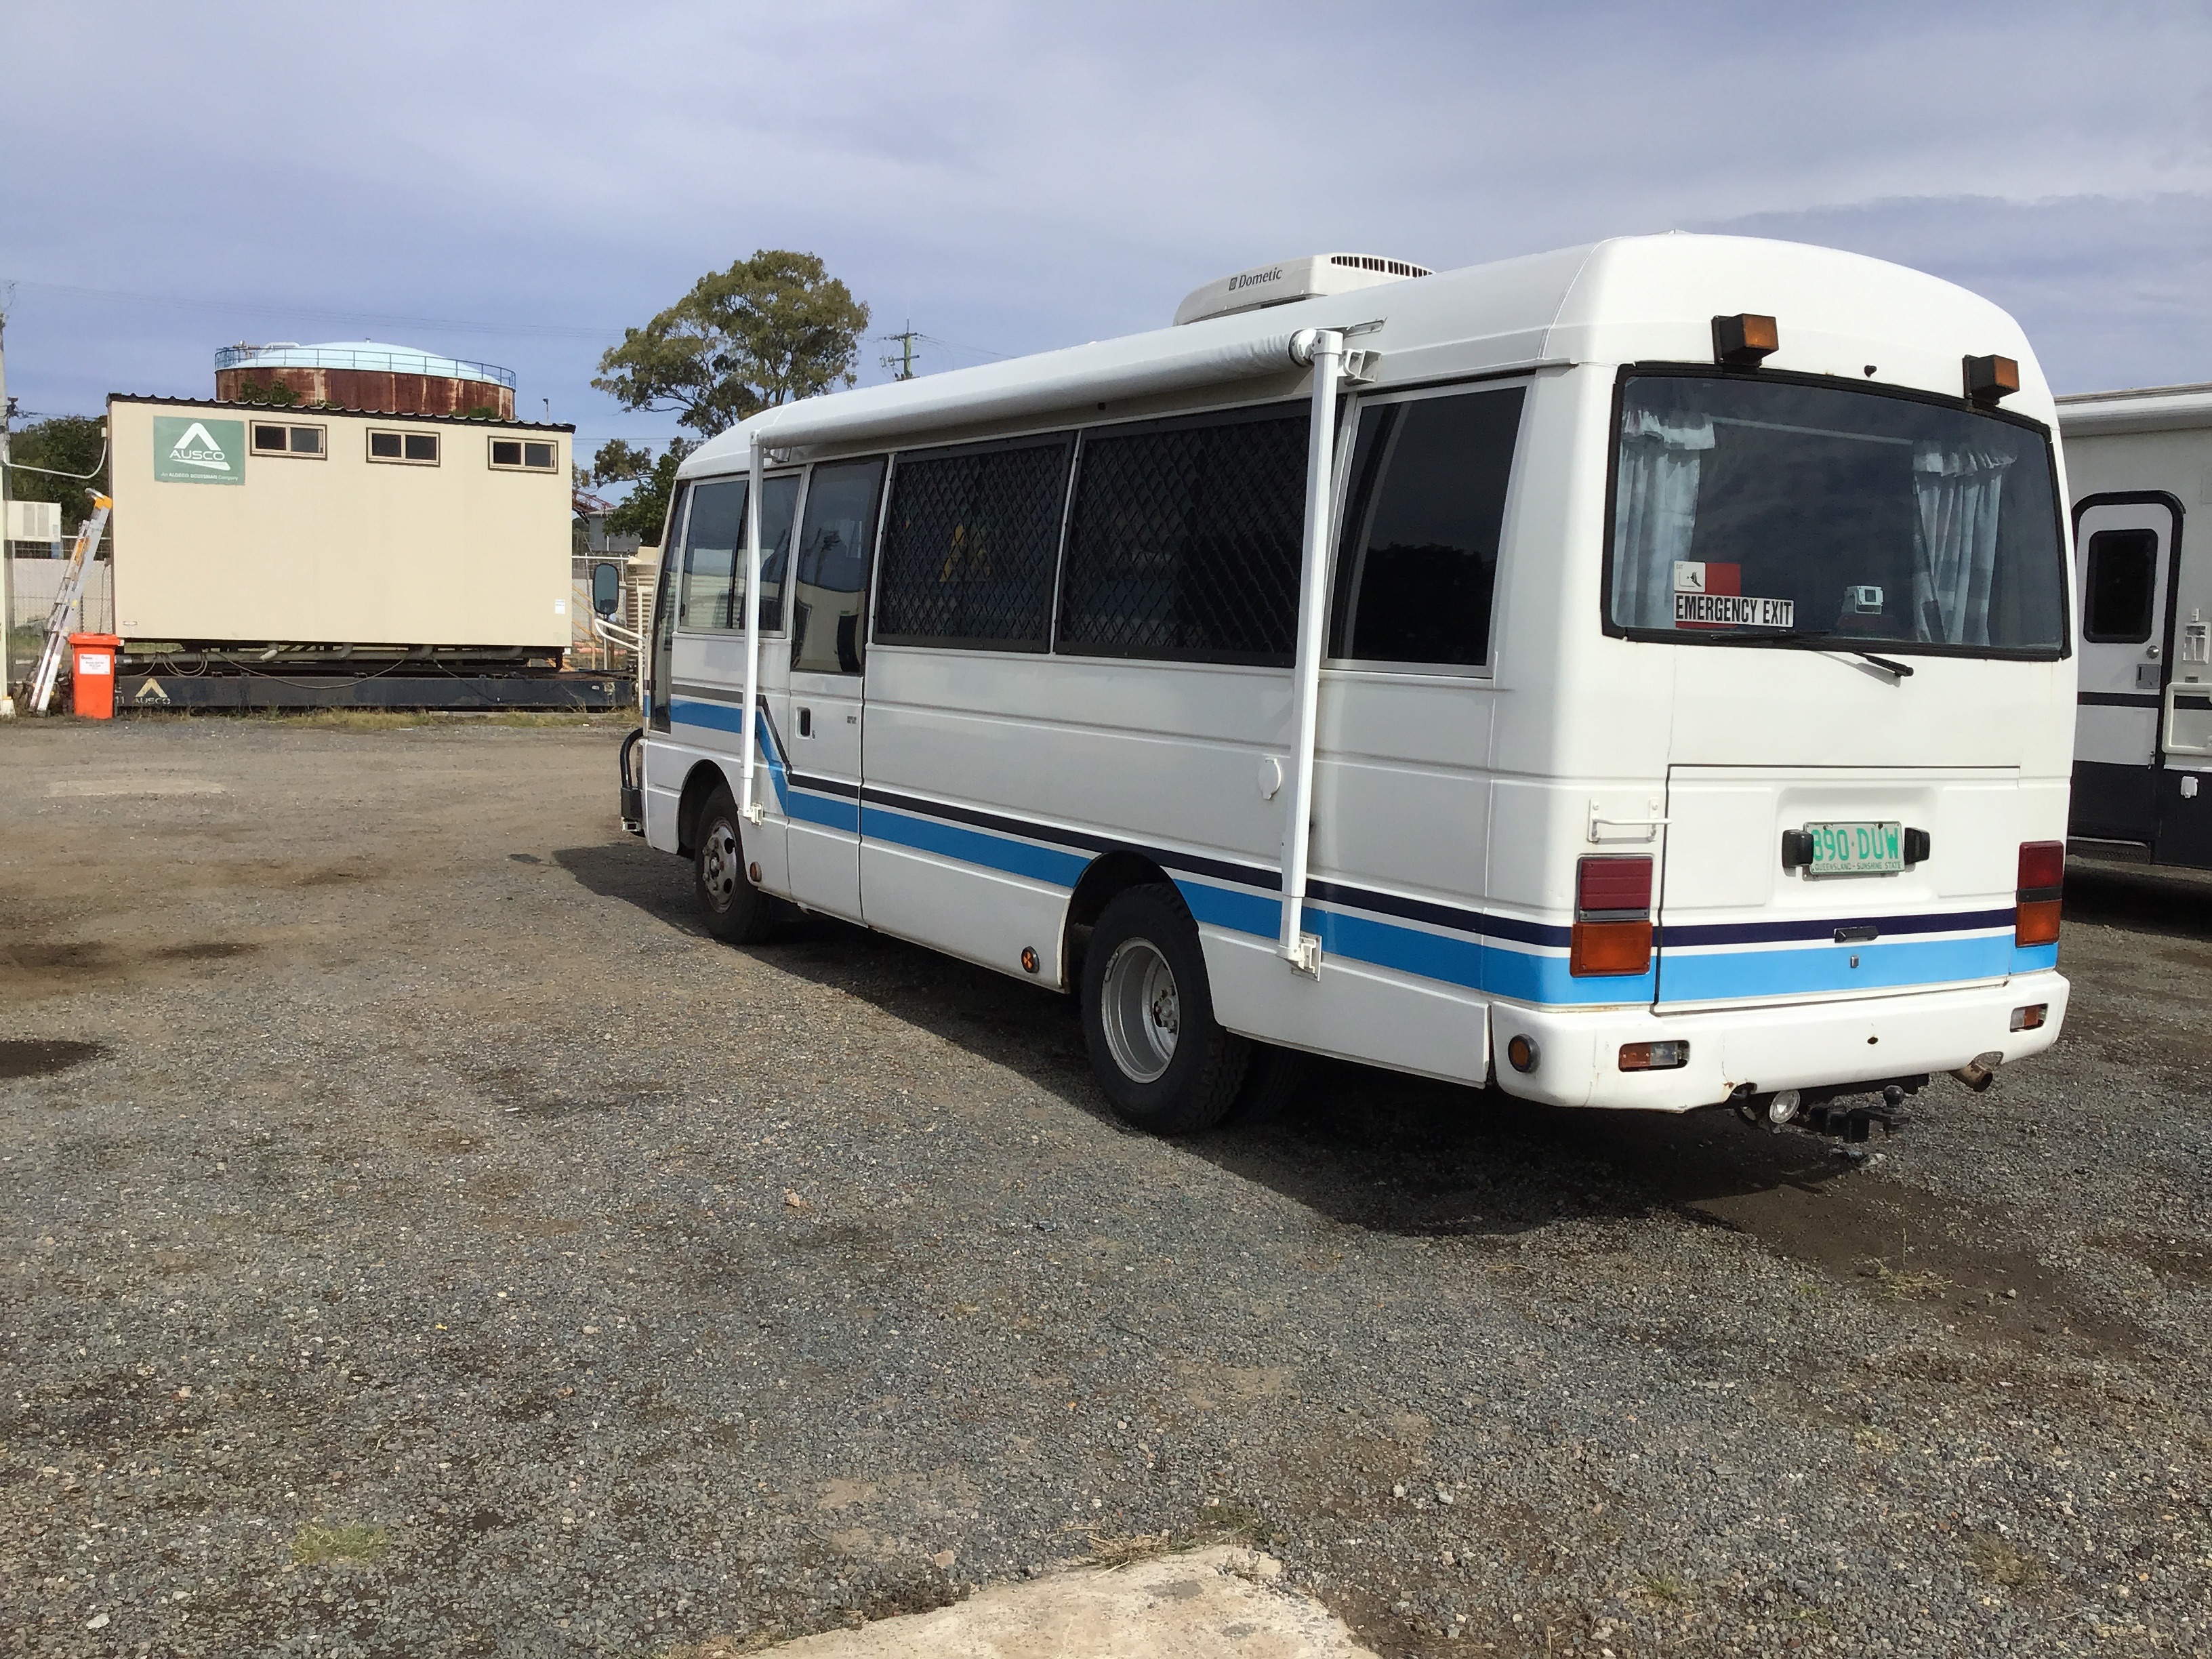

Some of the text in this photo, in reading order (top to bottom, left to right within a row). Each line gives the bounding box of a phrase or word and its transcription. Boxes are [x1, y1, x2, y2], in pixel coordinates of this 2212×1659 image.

[1238, 267, 1283, 289] Dometic
[169, 449, 225, 461] AUSCO
[1675, 595, 1792, 625] EMERGENCY EXIT
[1856, 862, 1882, 870] SUNSHINE
[1885, 861, 1901, 869] STATE
